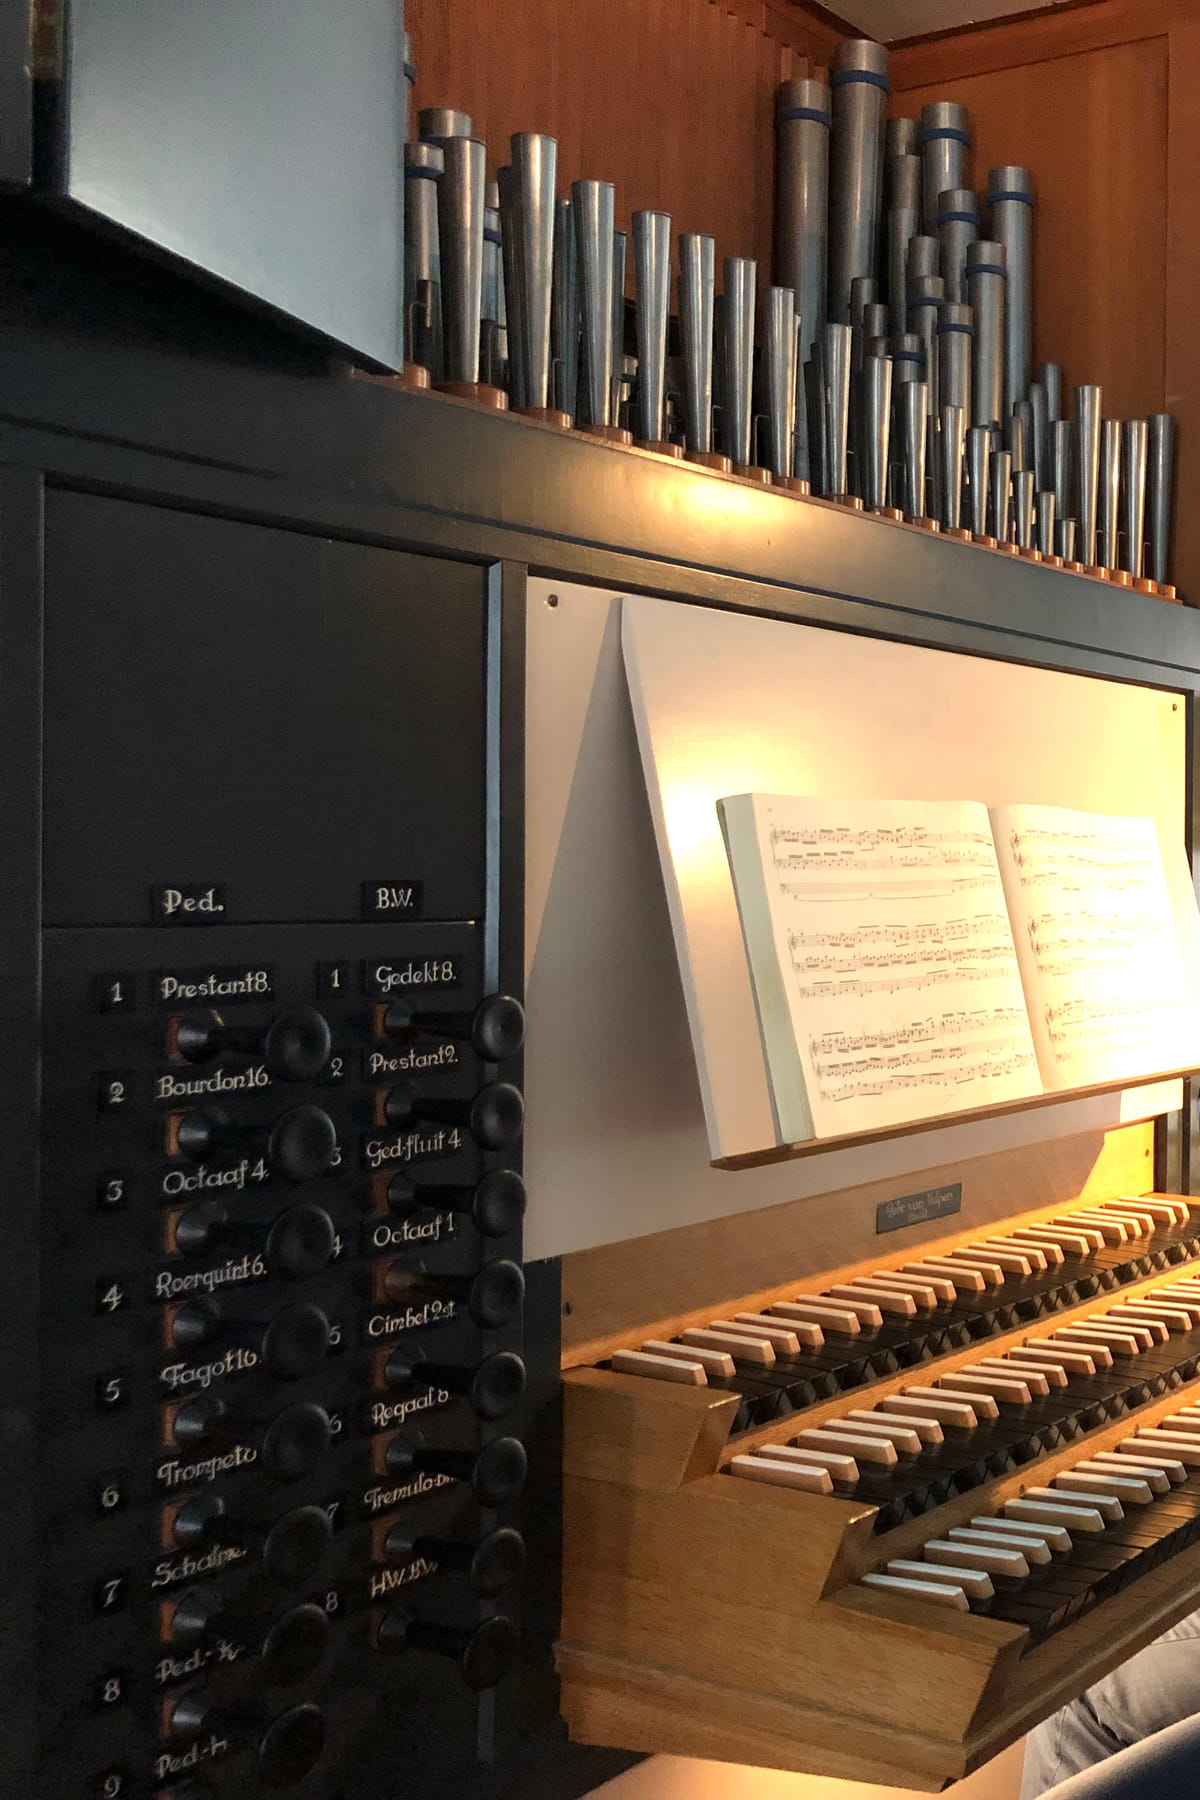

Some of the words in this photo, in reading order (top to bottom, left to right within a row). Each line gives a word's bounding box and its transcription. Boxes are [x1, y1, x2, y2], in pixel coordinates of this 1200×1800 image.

[163, 888, 224, 914] Ped.
[332, 968, 340, 988] 1
[111, 982, 123, 1002] 1
[330, 1057, 343, 1077] 2
[110, 1081, 125, 1104] 2
[107, 1180, 123, 1201] 3
[102, 1284, 123, 1311] 4
[329, 1326, 341, 1345] 5
[106, 1378, 120, 1402] 5
[328, 1414, 342, 1434] 6
[102, 1486, 120, 1508] 6
[104, 1578, 122, 1607] 7
[325, 1592, 338, 1612] 8
[103, 1679, 121, 1702] 8
[103, 1777, 121, 1799] 9
